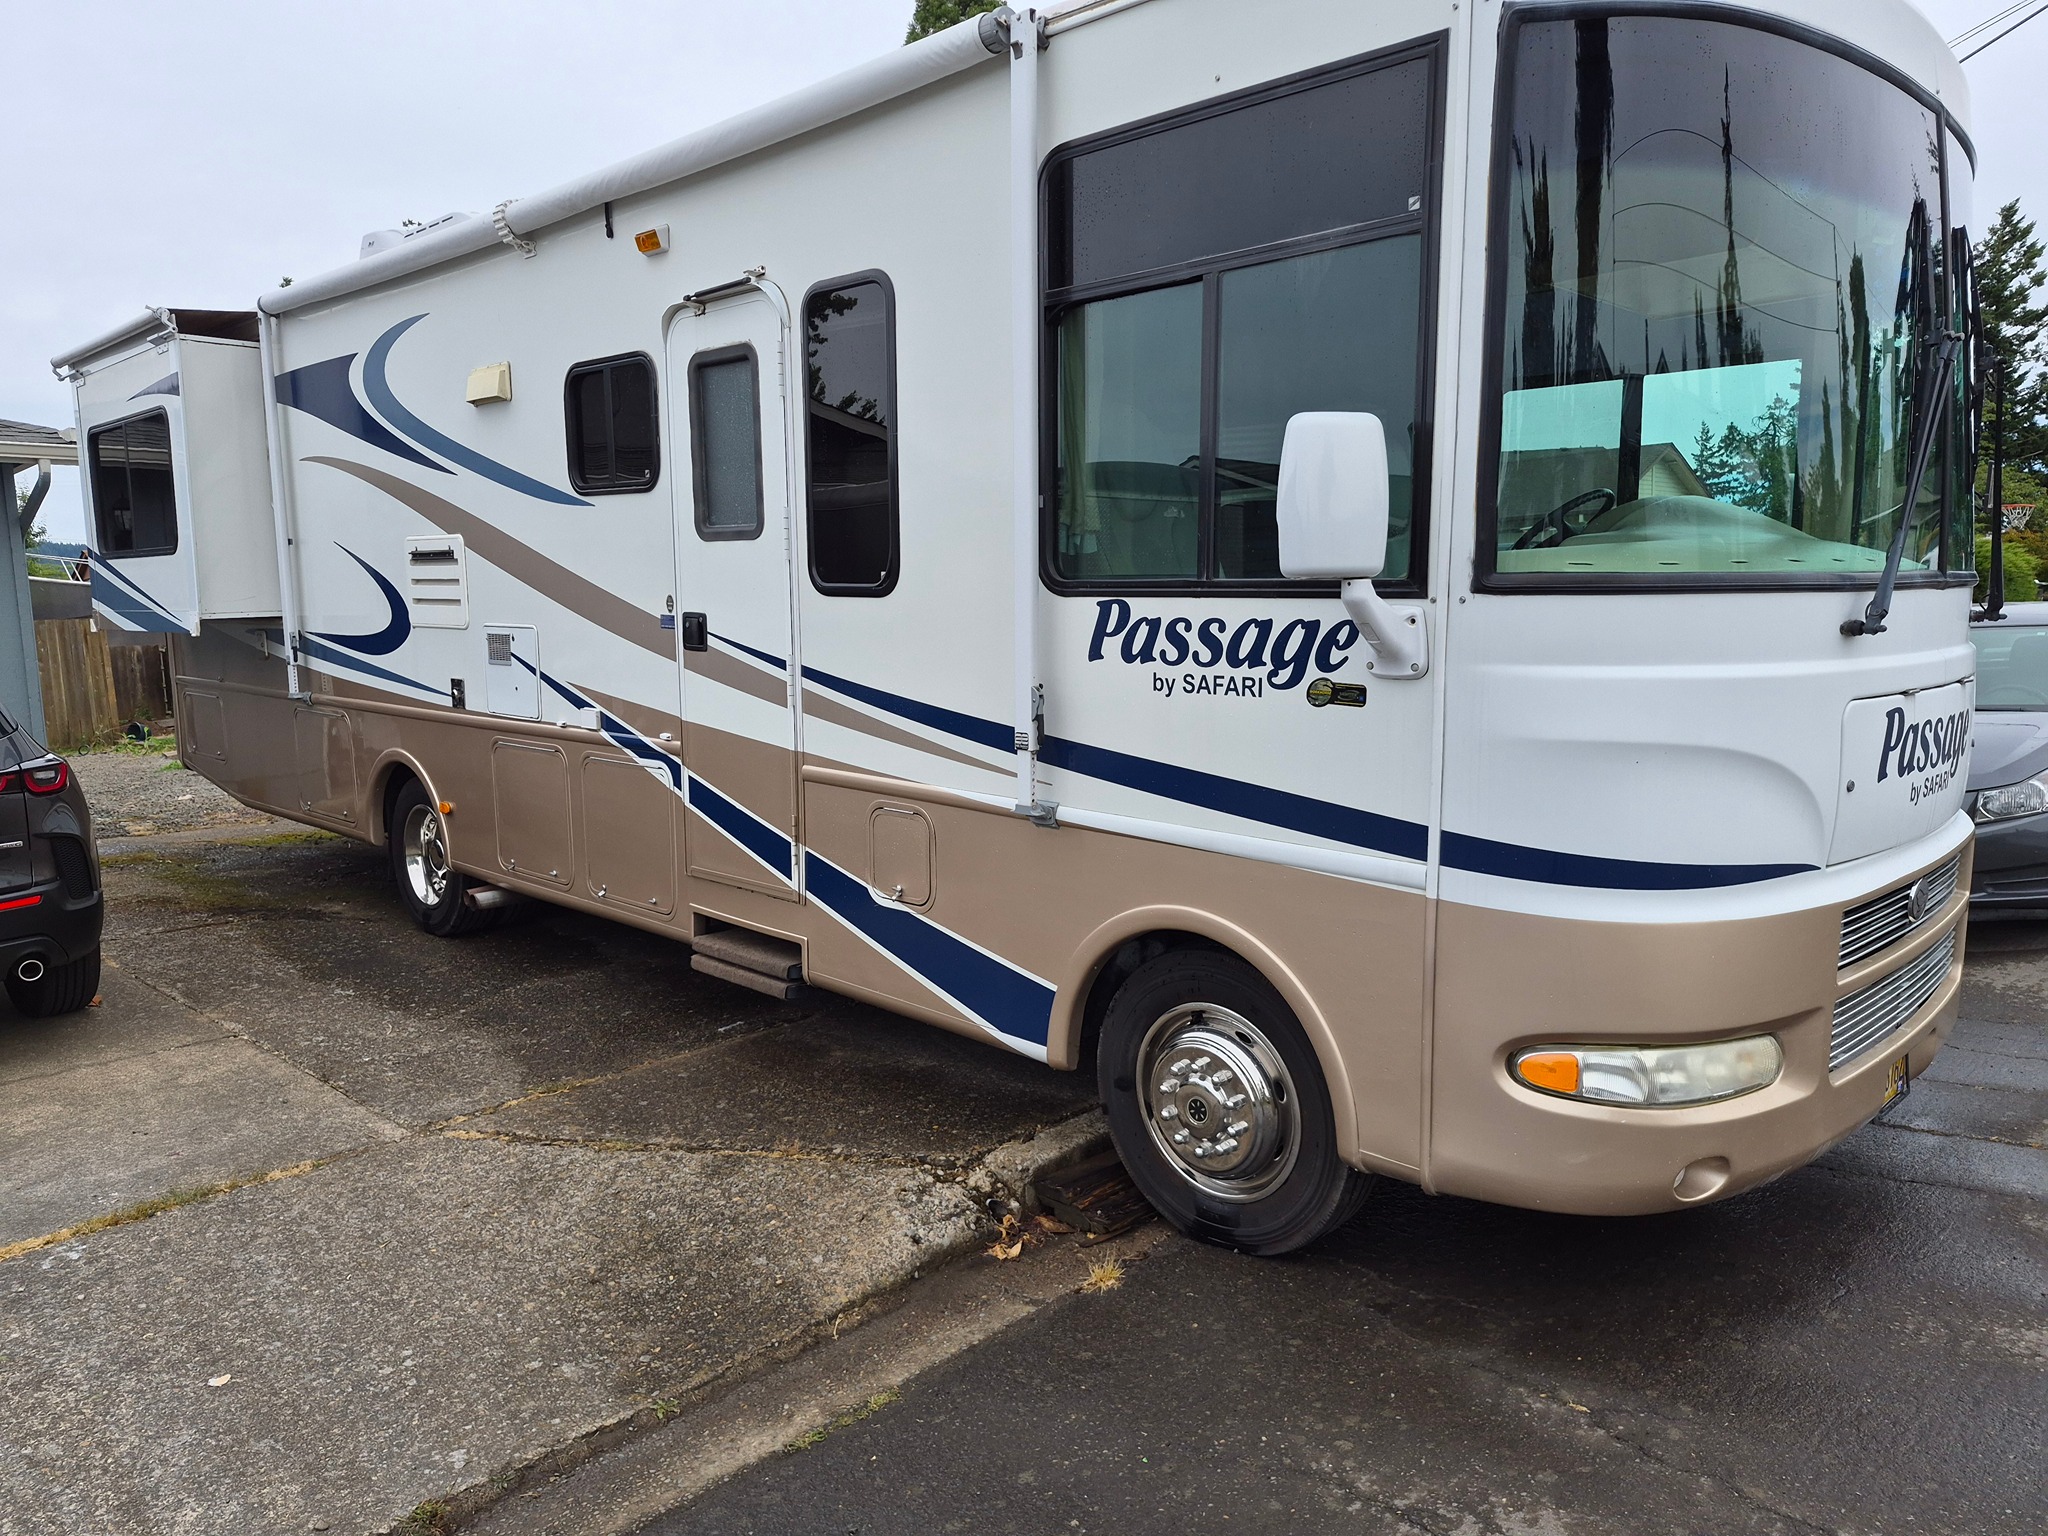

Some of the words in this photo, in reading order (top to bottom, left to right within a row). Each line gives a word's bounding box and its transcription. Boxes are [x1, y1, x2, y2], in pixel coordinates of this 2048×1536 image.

[1088, 598, 1359, 690] Passage
[1152, 672, 1176, 697] by
[1182, 673, 1263, 698] SAFARI
[1877, 706, 1969, 783] Passage
[1909, 781, 1922, 806] by
[1923, 770, 1949, 798] SAFARI
